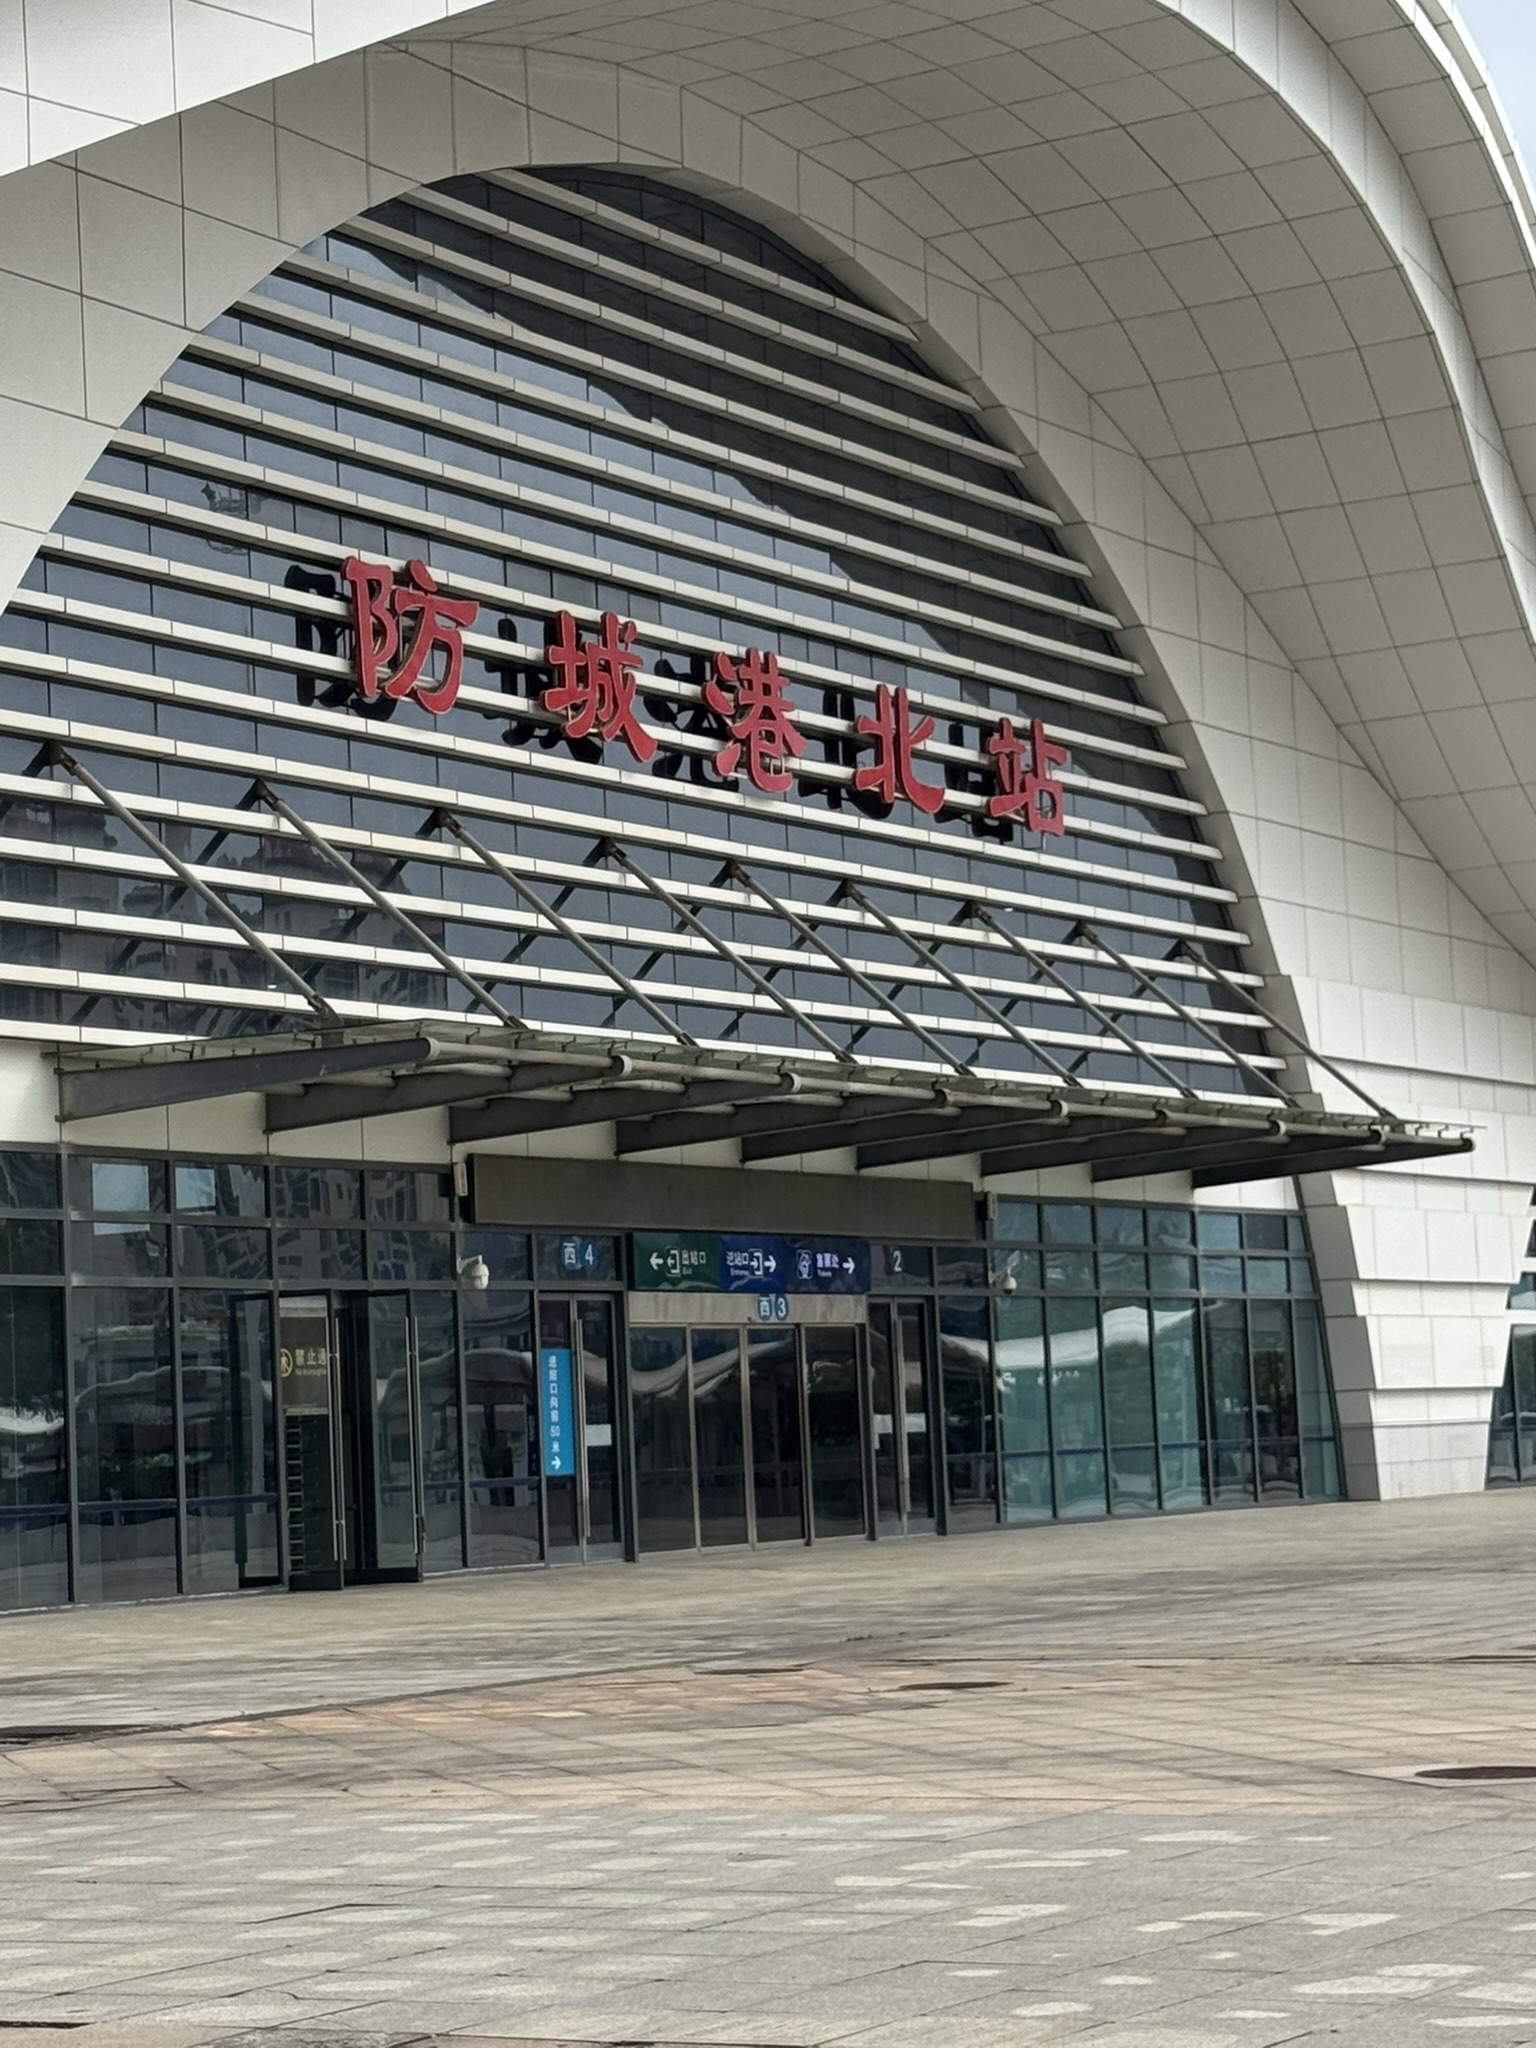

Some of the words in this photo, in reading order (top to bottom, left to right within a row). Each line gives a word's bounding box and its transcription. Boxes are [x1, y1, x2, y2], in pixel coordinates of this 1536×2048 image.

[341, 556, 1072, 837] 防城港北站
[681, 1249, 707, 1265] 出站口
[725, 1250, 750, 1266] 进站口
[892, 1250, 902, 1272] 2
